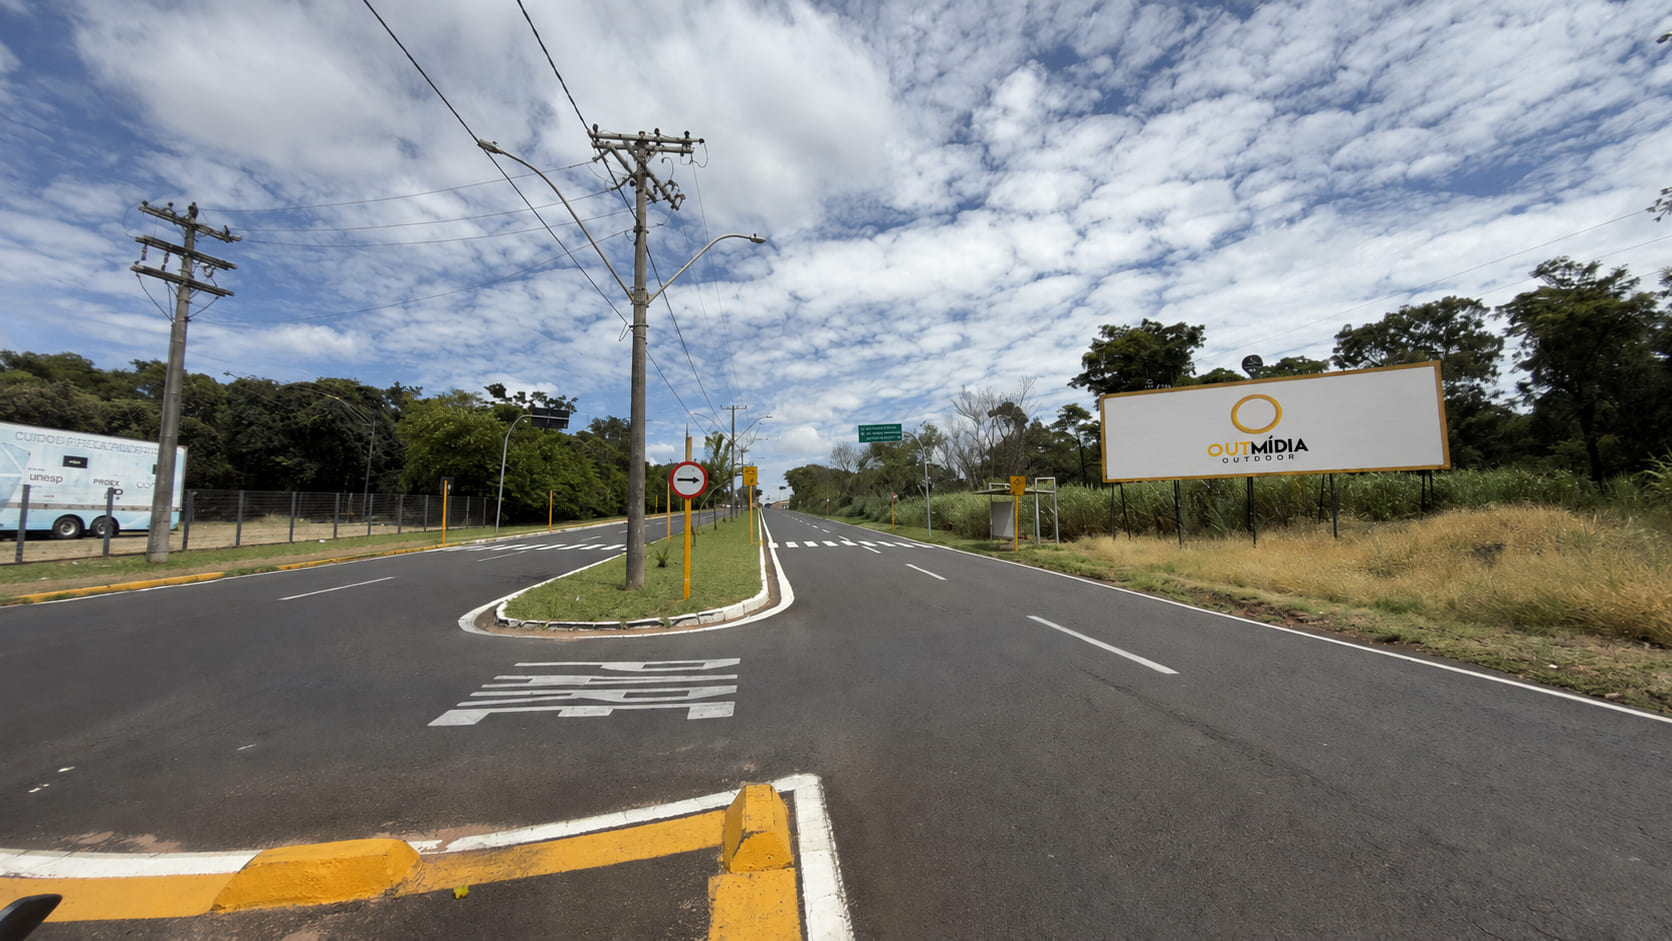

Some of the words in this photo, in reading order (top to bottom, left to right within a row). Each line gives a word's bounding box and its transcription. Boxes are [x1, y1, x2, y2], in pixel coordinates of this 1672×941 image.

[1207, 435, 1309, 457] OUTMÍDIA
[1222, 454, 1295, 464] OUTDOOR
[29, 472, 64, 484] unesp
